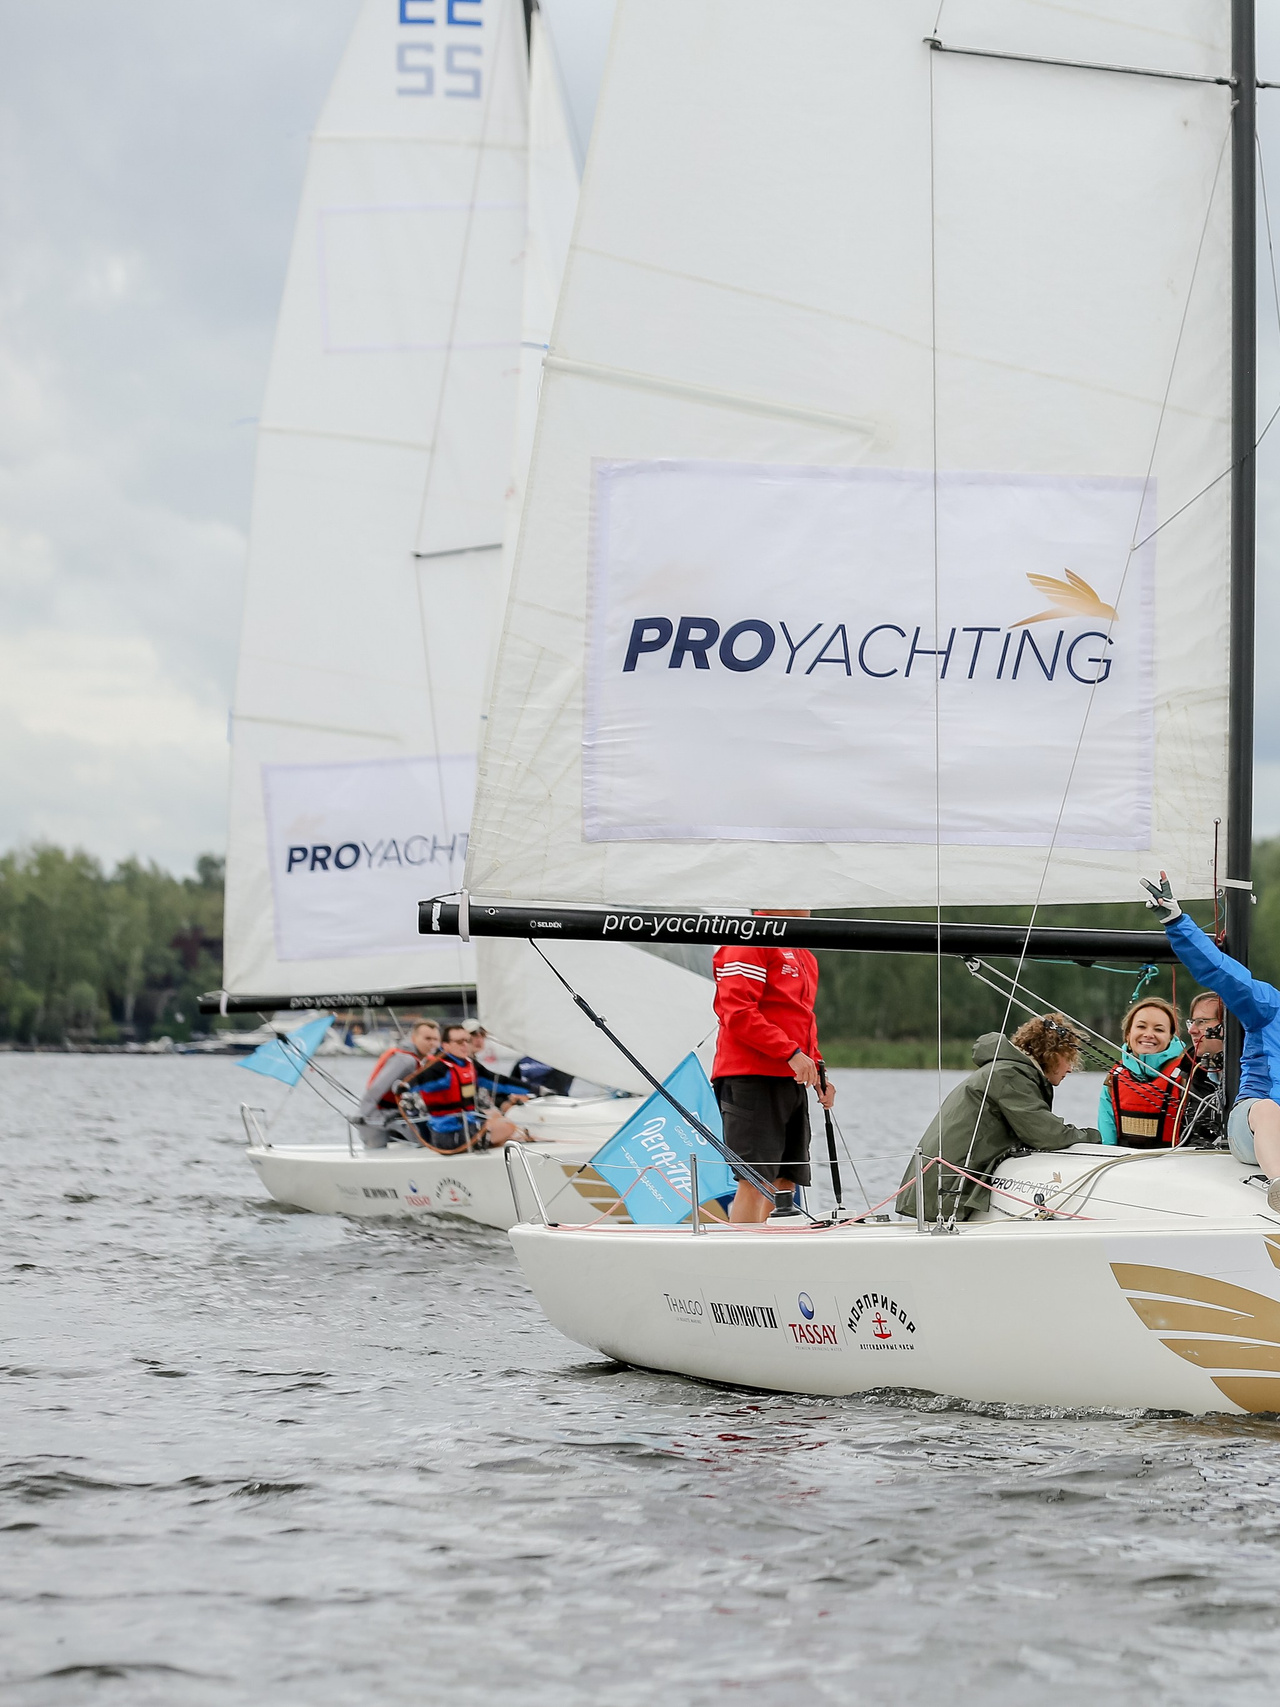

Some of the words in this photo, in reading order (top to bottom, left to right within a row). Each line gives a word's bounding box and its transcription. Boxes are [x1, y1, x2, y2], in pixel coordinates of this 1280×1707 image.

[622, 616, 1113, 684] PROYACHTING
[603, 914, 788, 939] pro-yachting.ru
[674, 1125, 694, 1149] GROUP
[710, 1302, 779, 1329] ВЕДОМОСТИ
[847, 1293, 916, 1334] МОРПРИБОР
[788, 1323, 838, 1344] TASSAY
